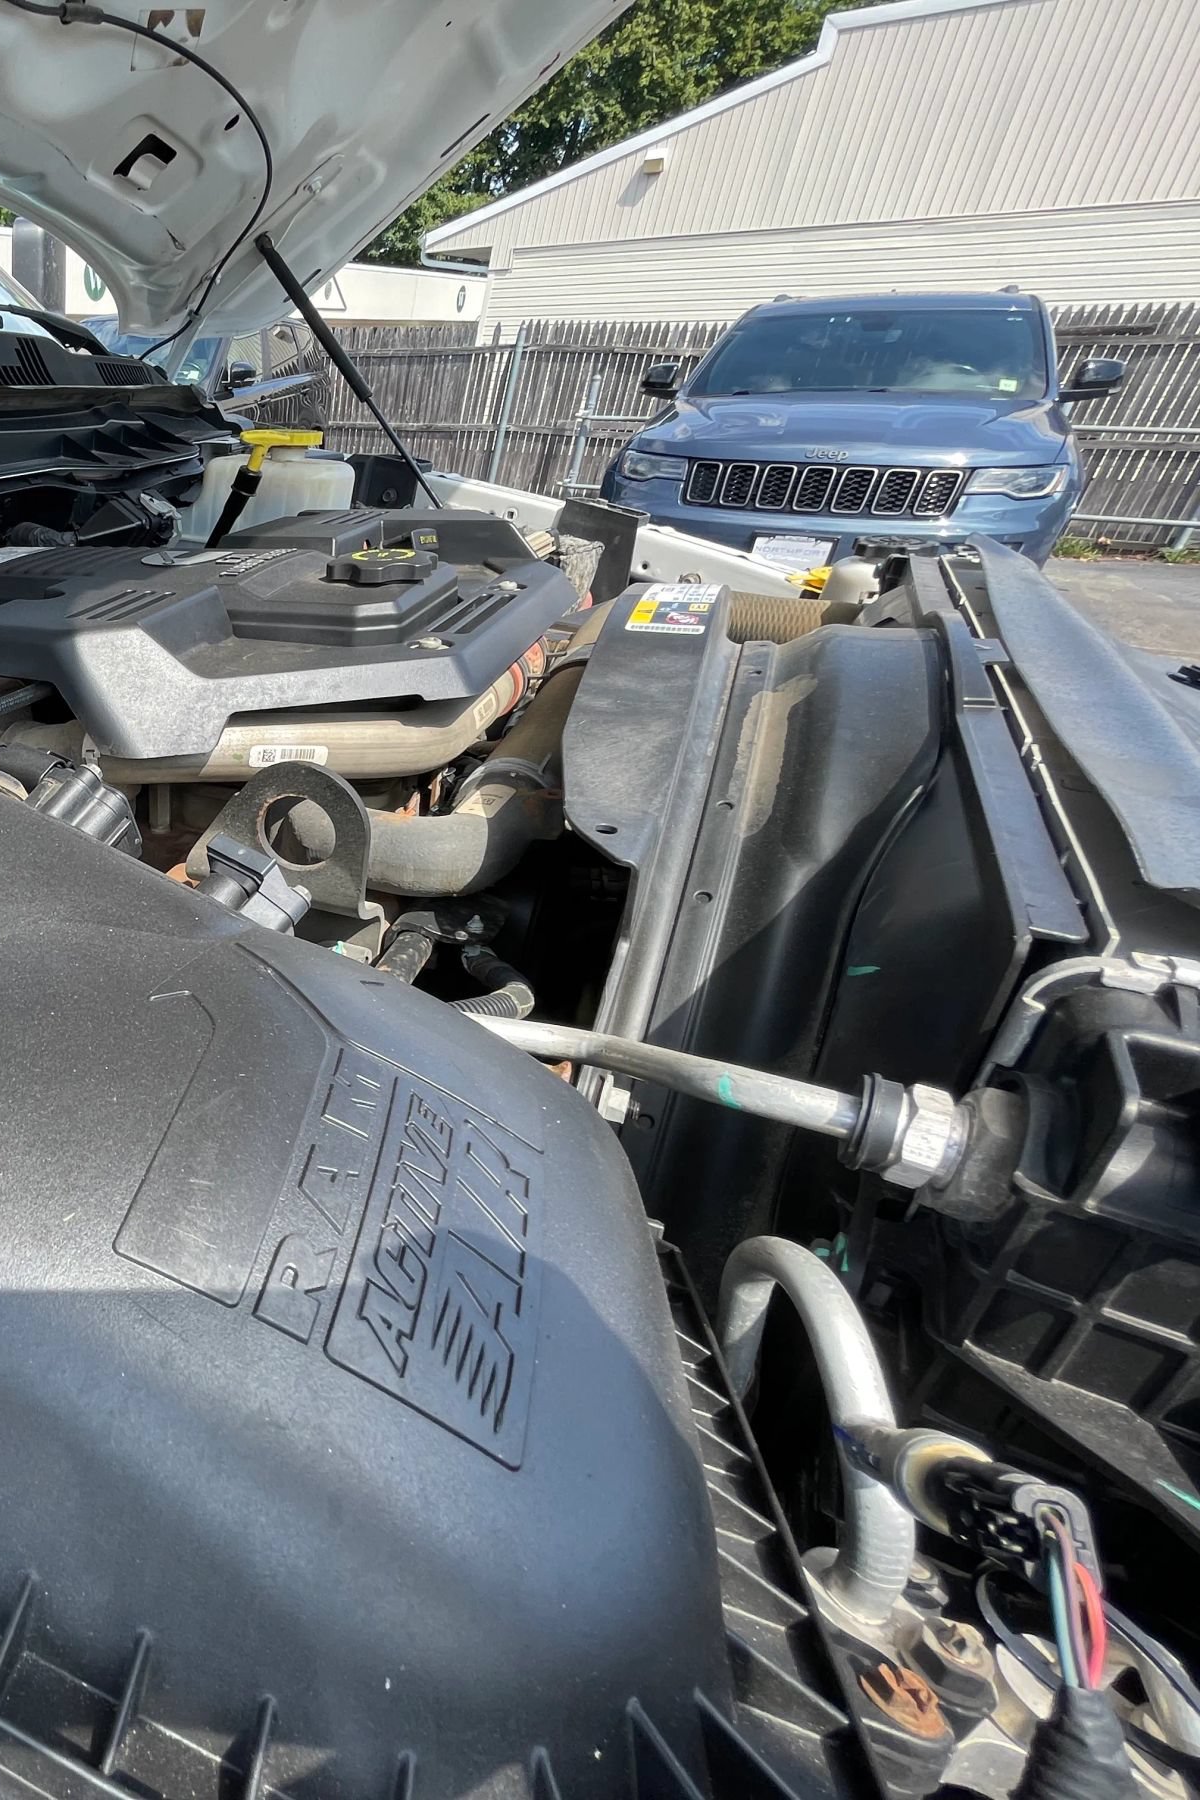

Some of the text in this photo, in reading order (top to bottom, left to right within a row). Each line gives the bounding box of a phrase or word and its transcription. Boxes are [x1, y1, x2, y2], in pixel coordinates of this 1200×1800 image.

[805, 447, 849, 462] Jeep
[252, 1047, 381, 1345] RAM
[357, 1088, 454, 1378] ACTIVE
[430, 1117, 531, 1434] AIR
